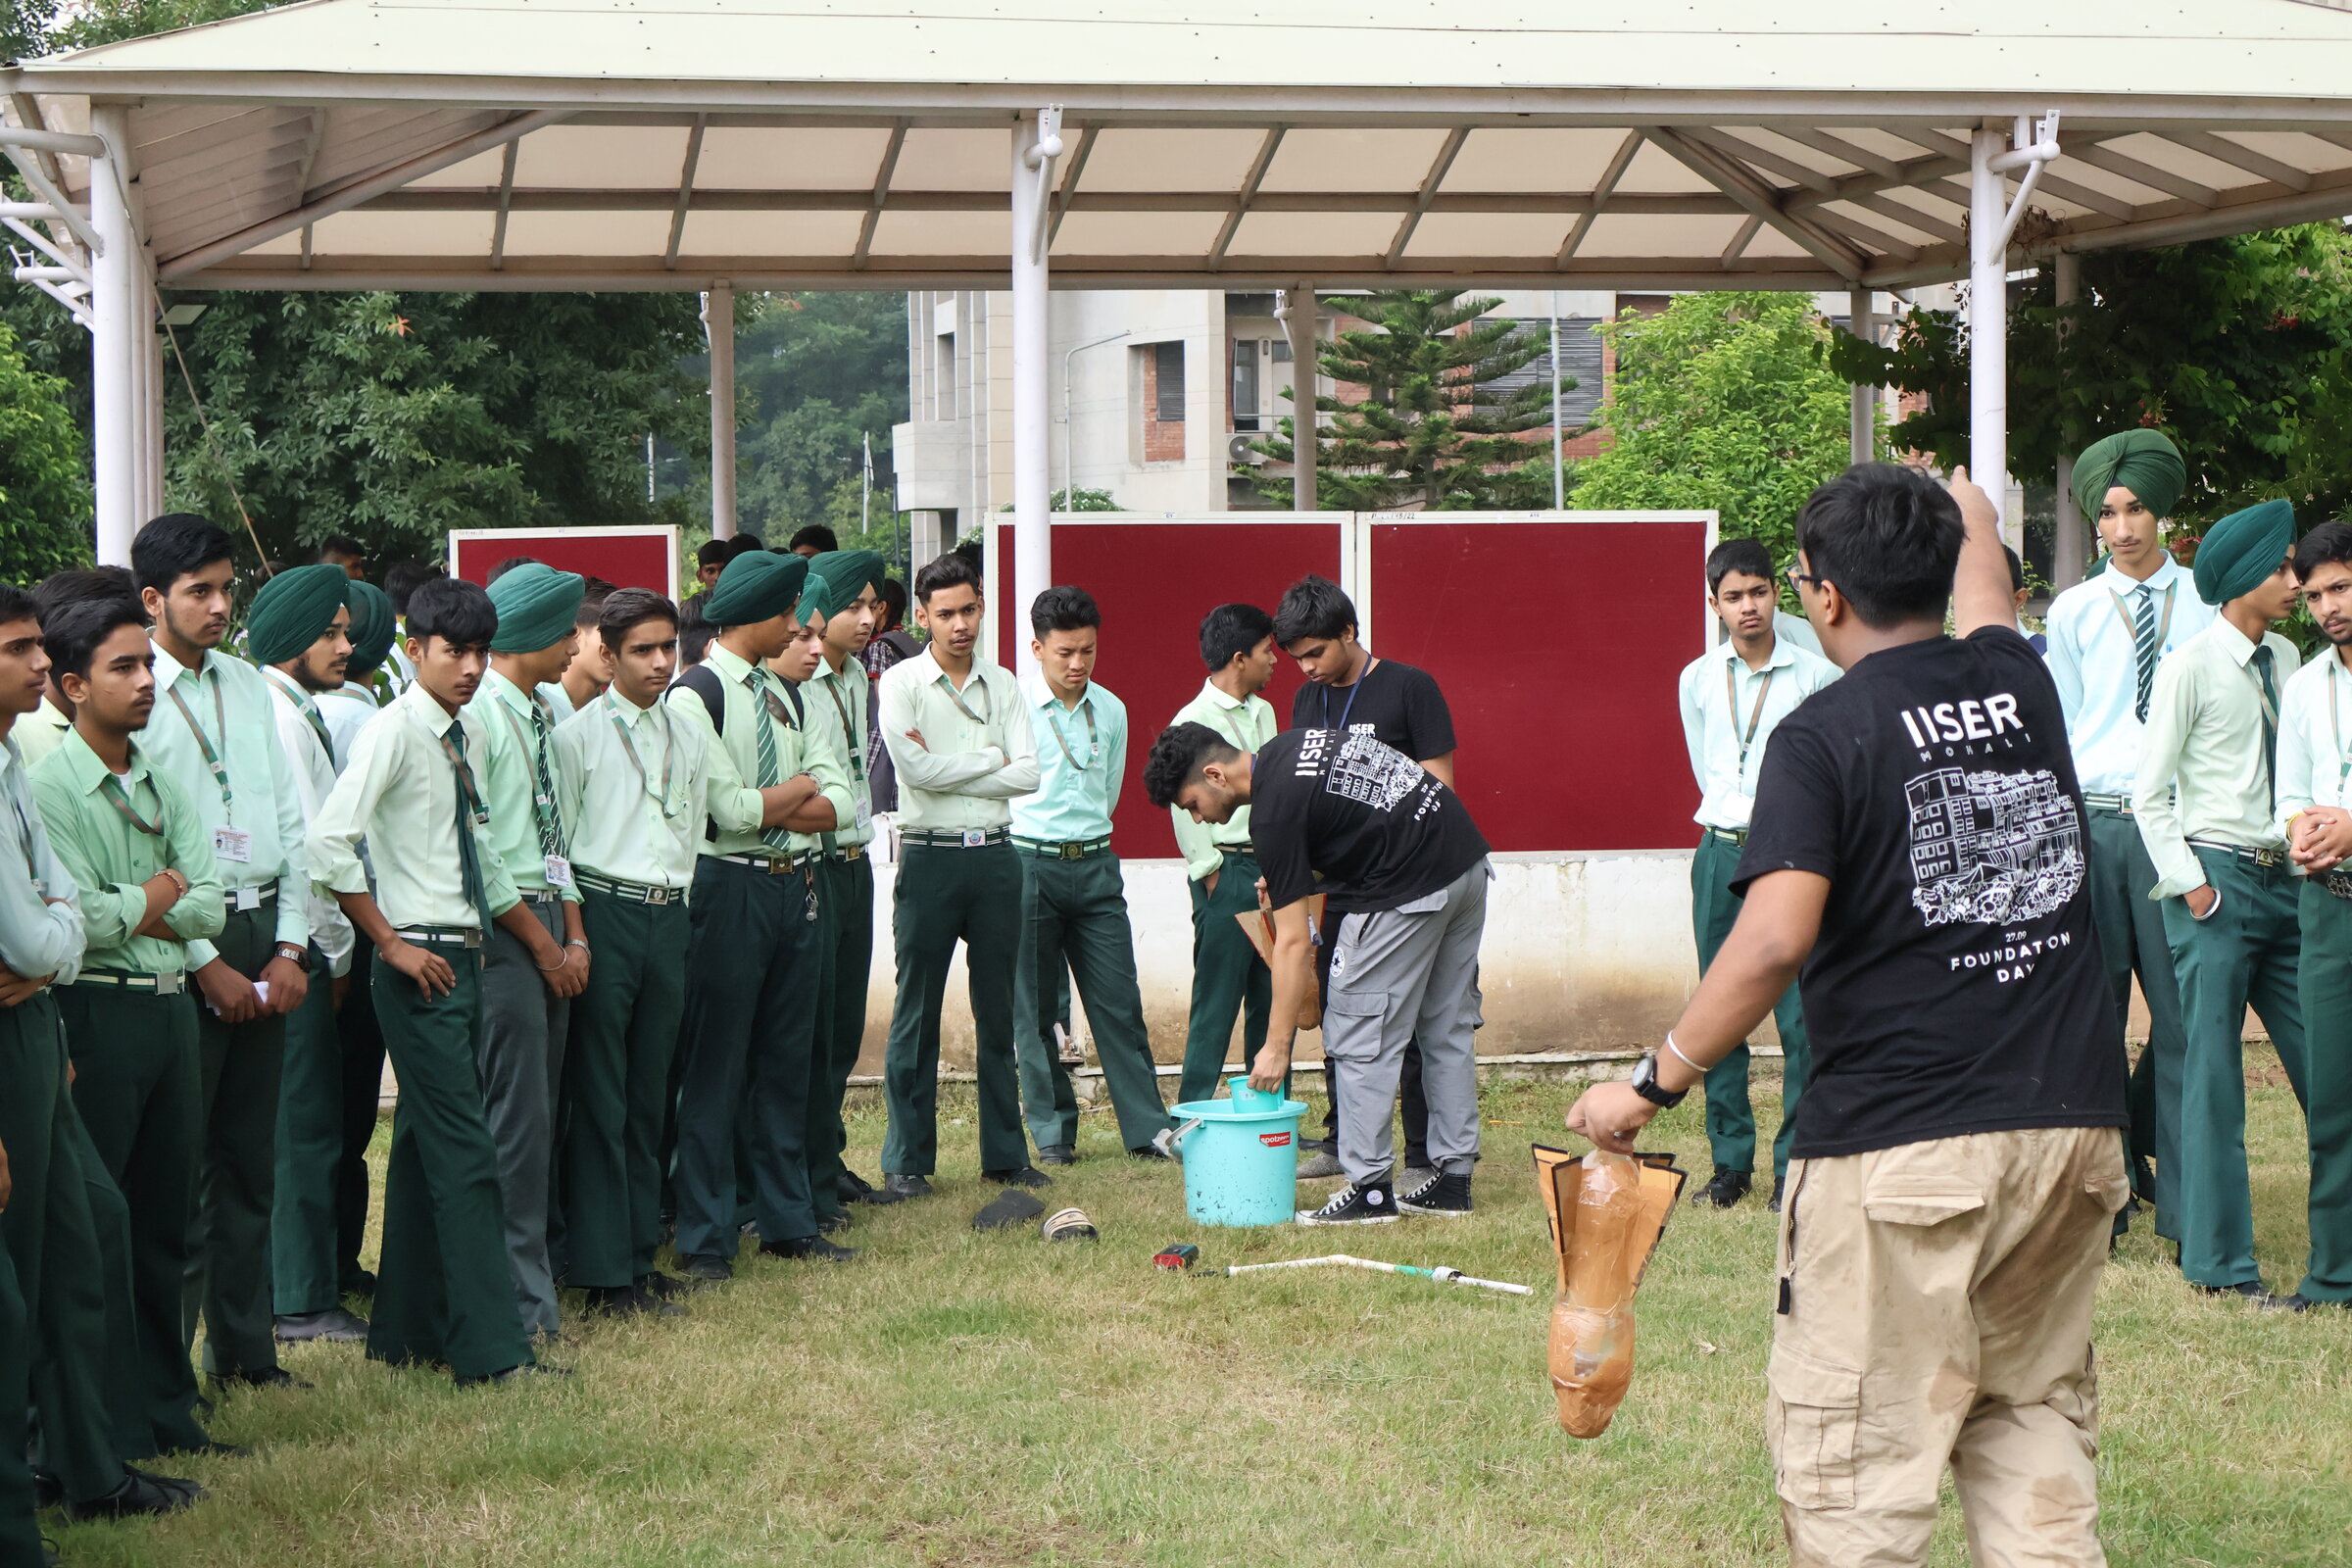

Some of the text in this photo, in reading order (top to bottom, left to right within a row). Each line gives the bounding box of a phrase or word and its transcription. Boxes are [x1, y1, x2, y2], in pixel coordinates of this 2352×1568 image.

[1348, 723, 1376, 738] IISER
[1900, 693, 2024, 749] IISER
[1295, 729, 1328, 776] IISER
[1921, 733, 2032, 762] MOHALI
[1950, 931, 2071, 971] FOUNDATON
[2005, 930, 2027, 943] 27.09
[1996, 963, 2034, 983] DAY
